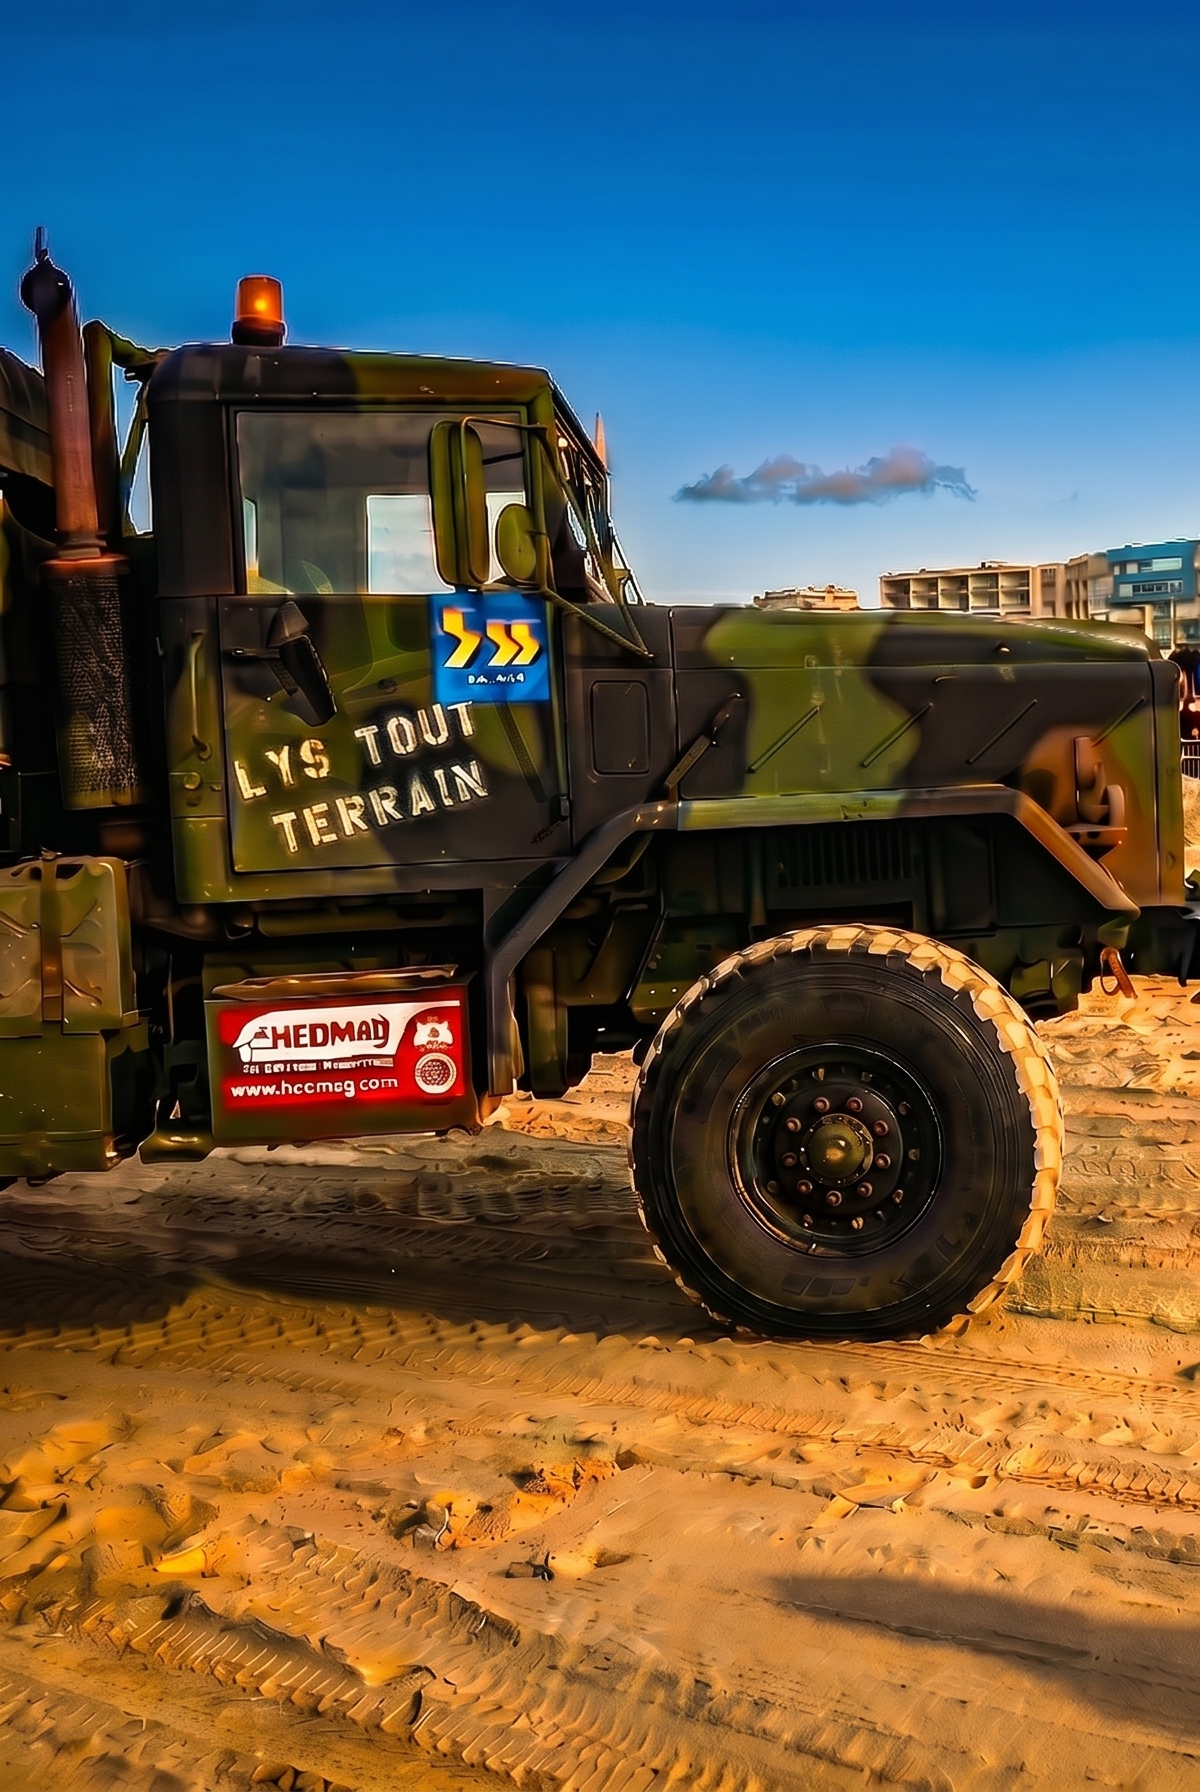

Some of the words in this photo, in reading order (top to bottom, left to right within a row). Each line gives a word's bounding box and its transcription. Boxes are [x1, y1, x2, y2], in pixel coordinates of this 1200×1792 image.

[233, 738, 331, 801] LYS
[354, 701, 477, 766] TOUT
[271, 759, 490, 854] TERRAIN
